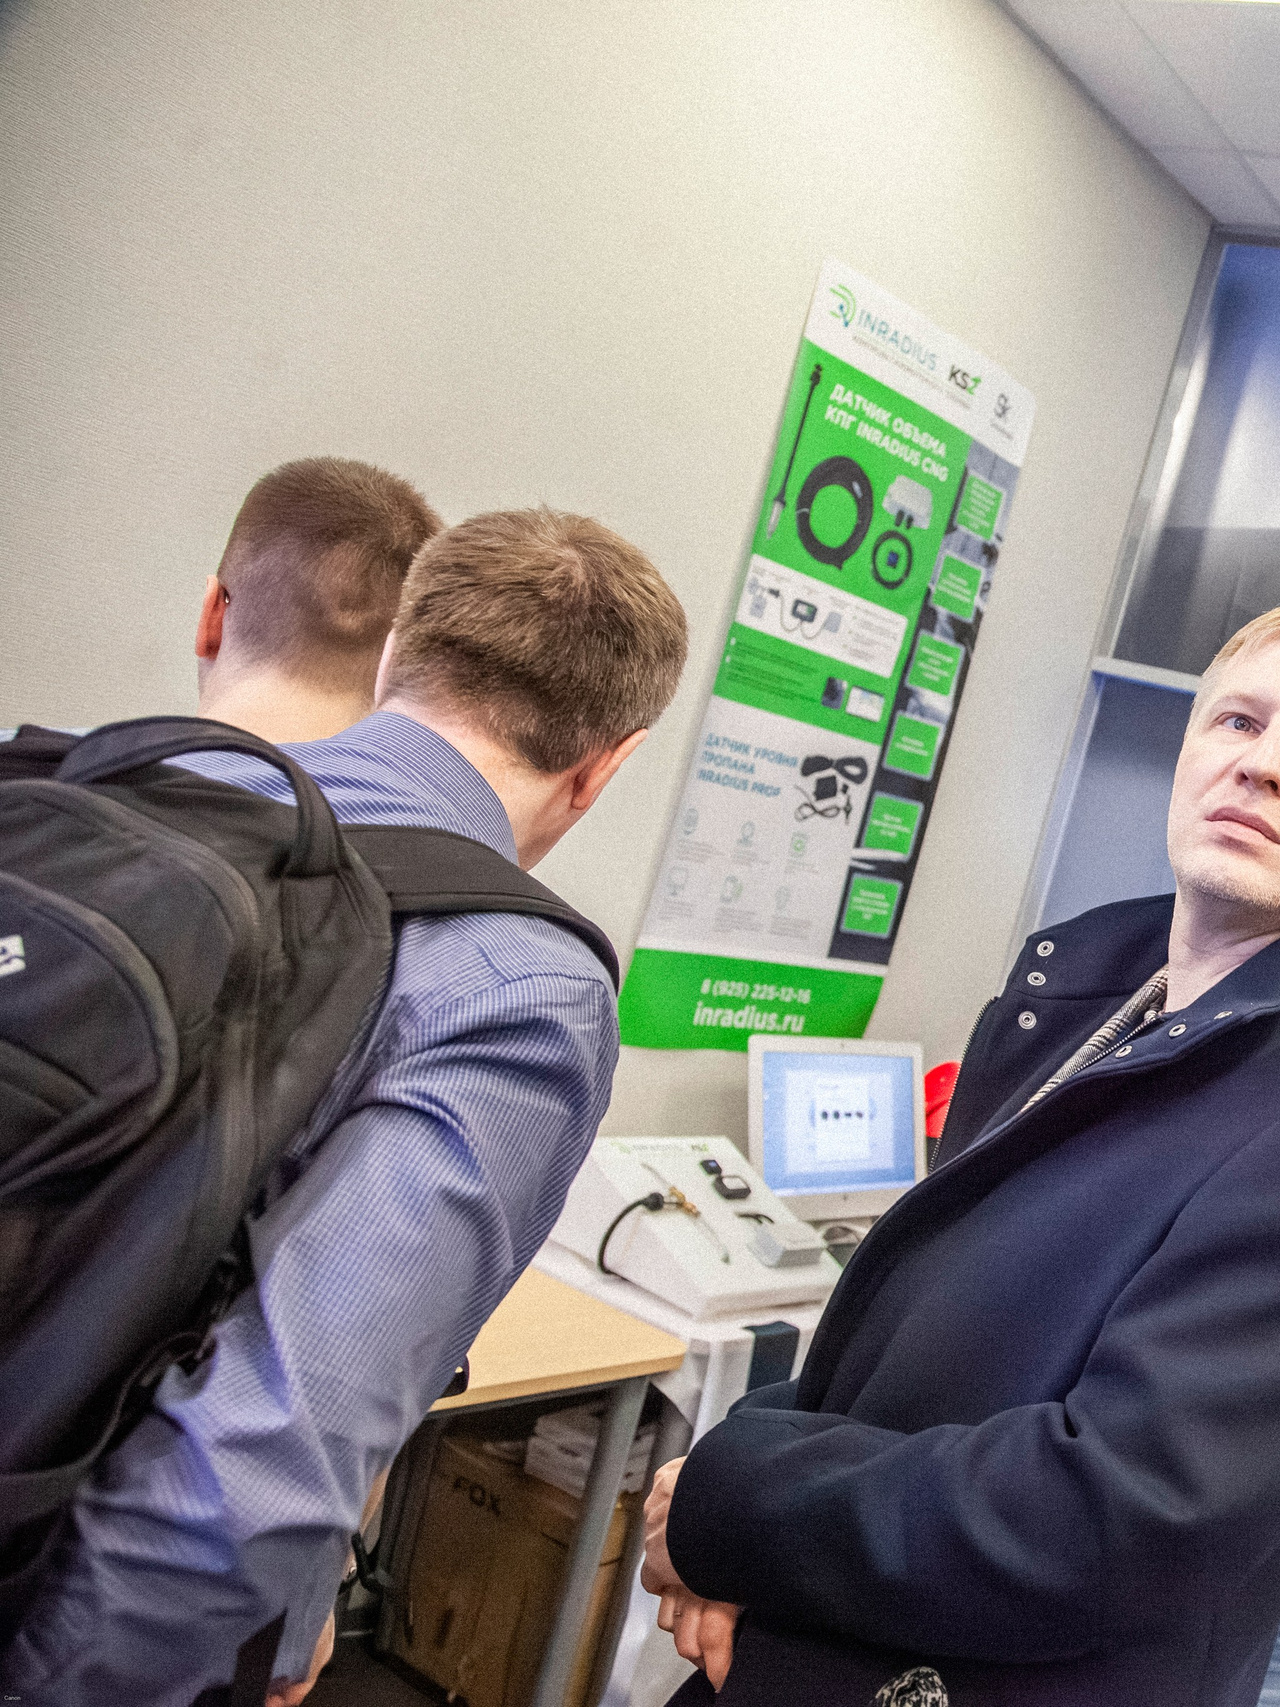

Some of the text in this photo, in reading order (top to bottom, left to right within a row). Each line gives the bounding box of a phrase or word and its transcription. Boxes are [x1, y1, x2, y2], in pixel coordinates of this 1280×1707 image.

[857, 308, 937, 371] INRADIUS
[824, 404, 949, 482] КПГ INRADIUS CNG
[829, 383, 947, 457] ДАТЧИК ОБЪЕМА
[702, 750, 755, 774] ПРОПАНА
[705, 732, 798, 768] ДАТЧИК УРОВНЯ
[693, 1001, 805, 1033] inradius.ru
